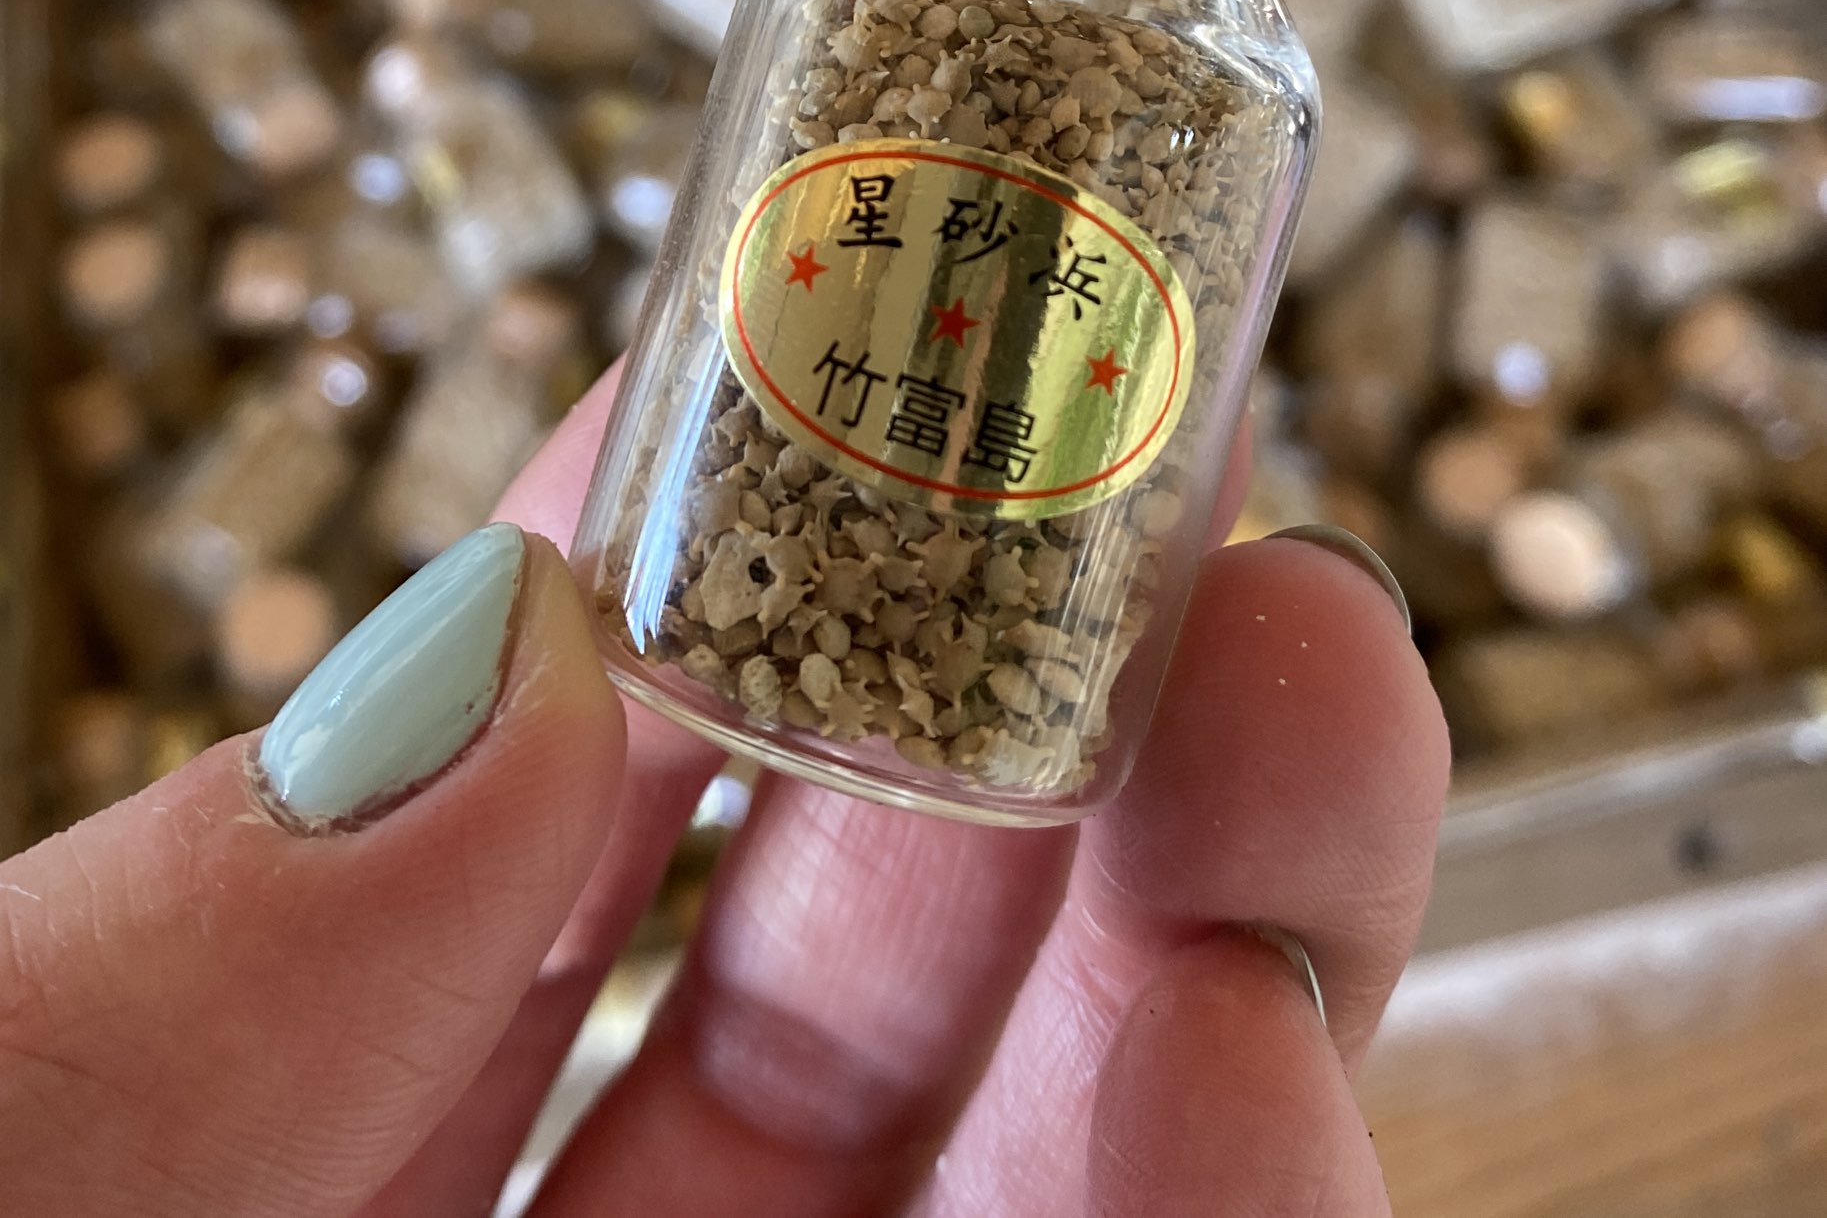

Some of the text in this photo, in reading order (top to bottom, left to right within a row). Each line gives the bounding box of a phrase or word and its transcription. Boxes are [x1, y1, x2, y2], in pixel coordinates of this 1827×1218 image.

[836, 173, 1107, 321] 星砂浜
[812, 340, 1039, 483] 竹富島
